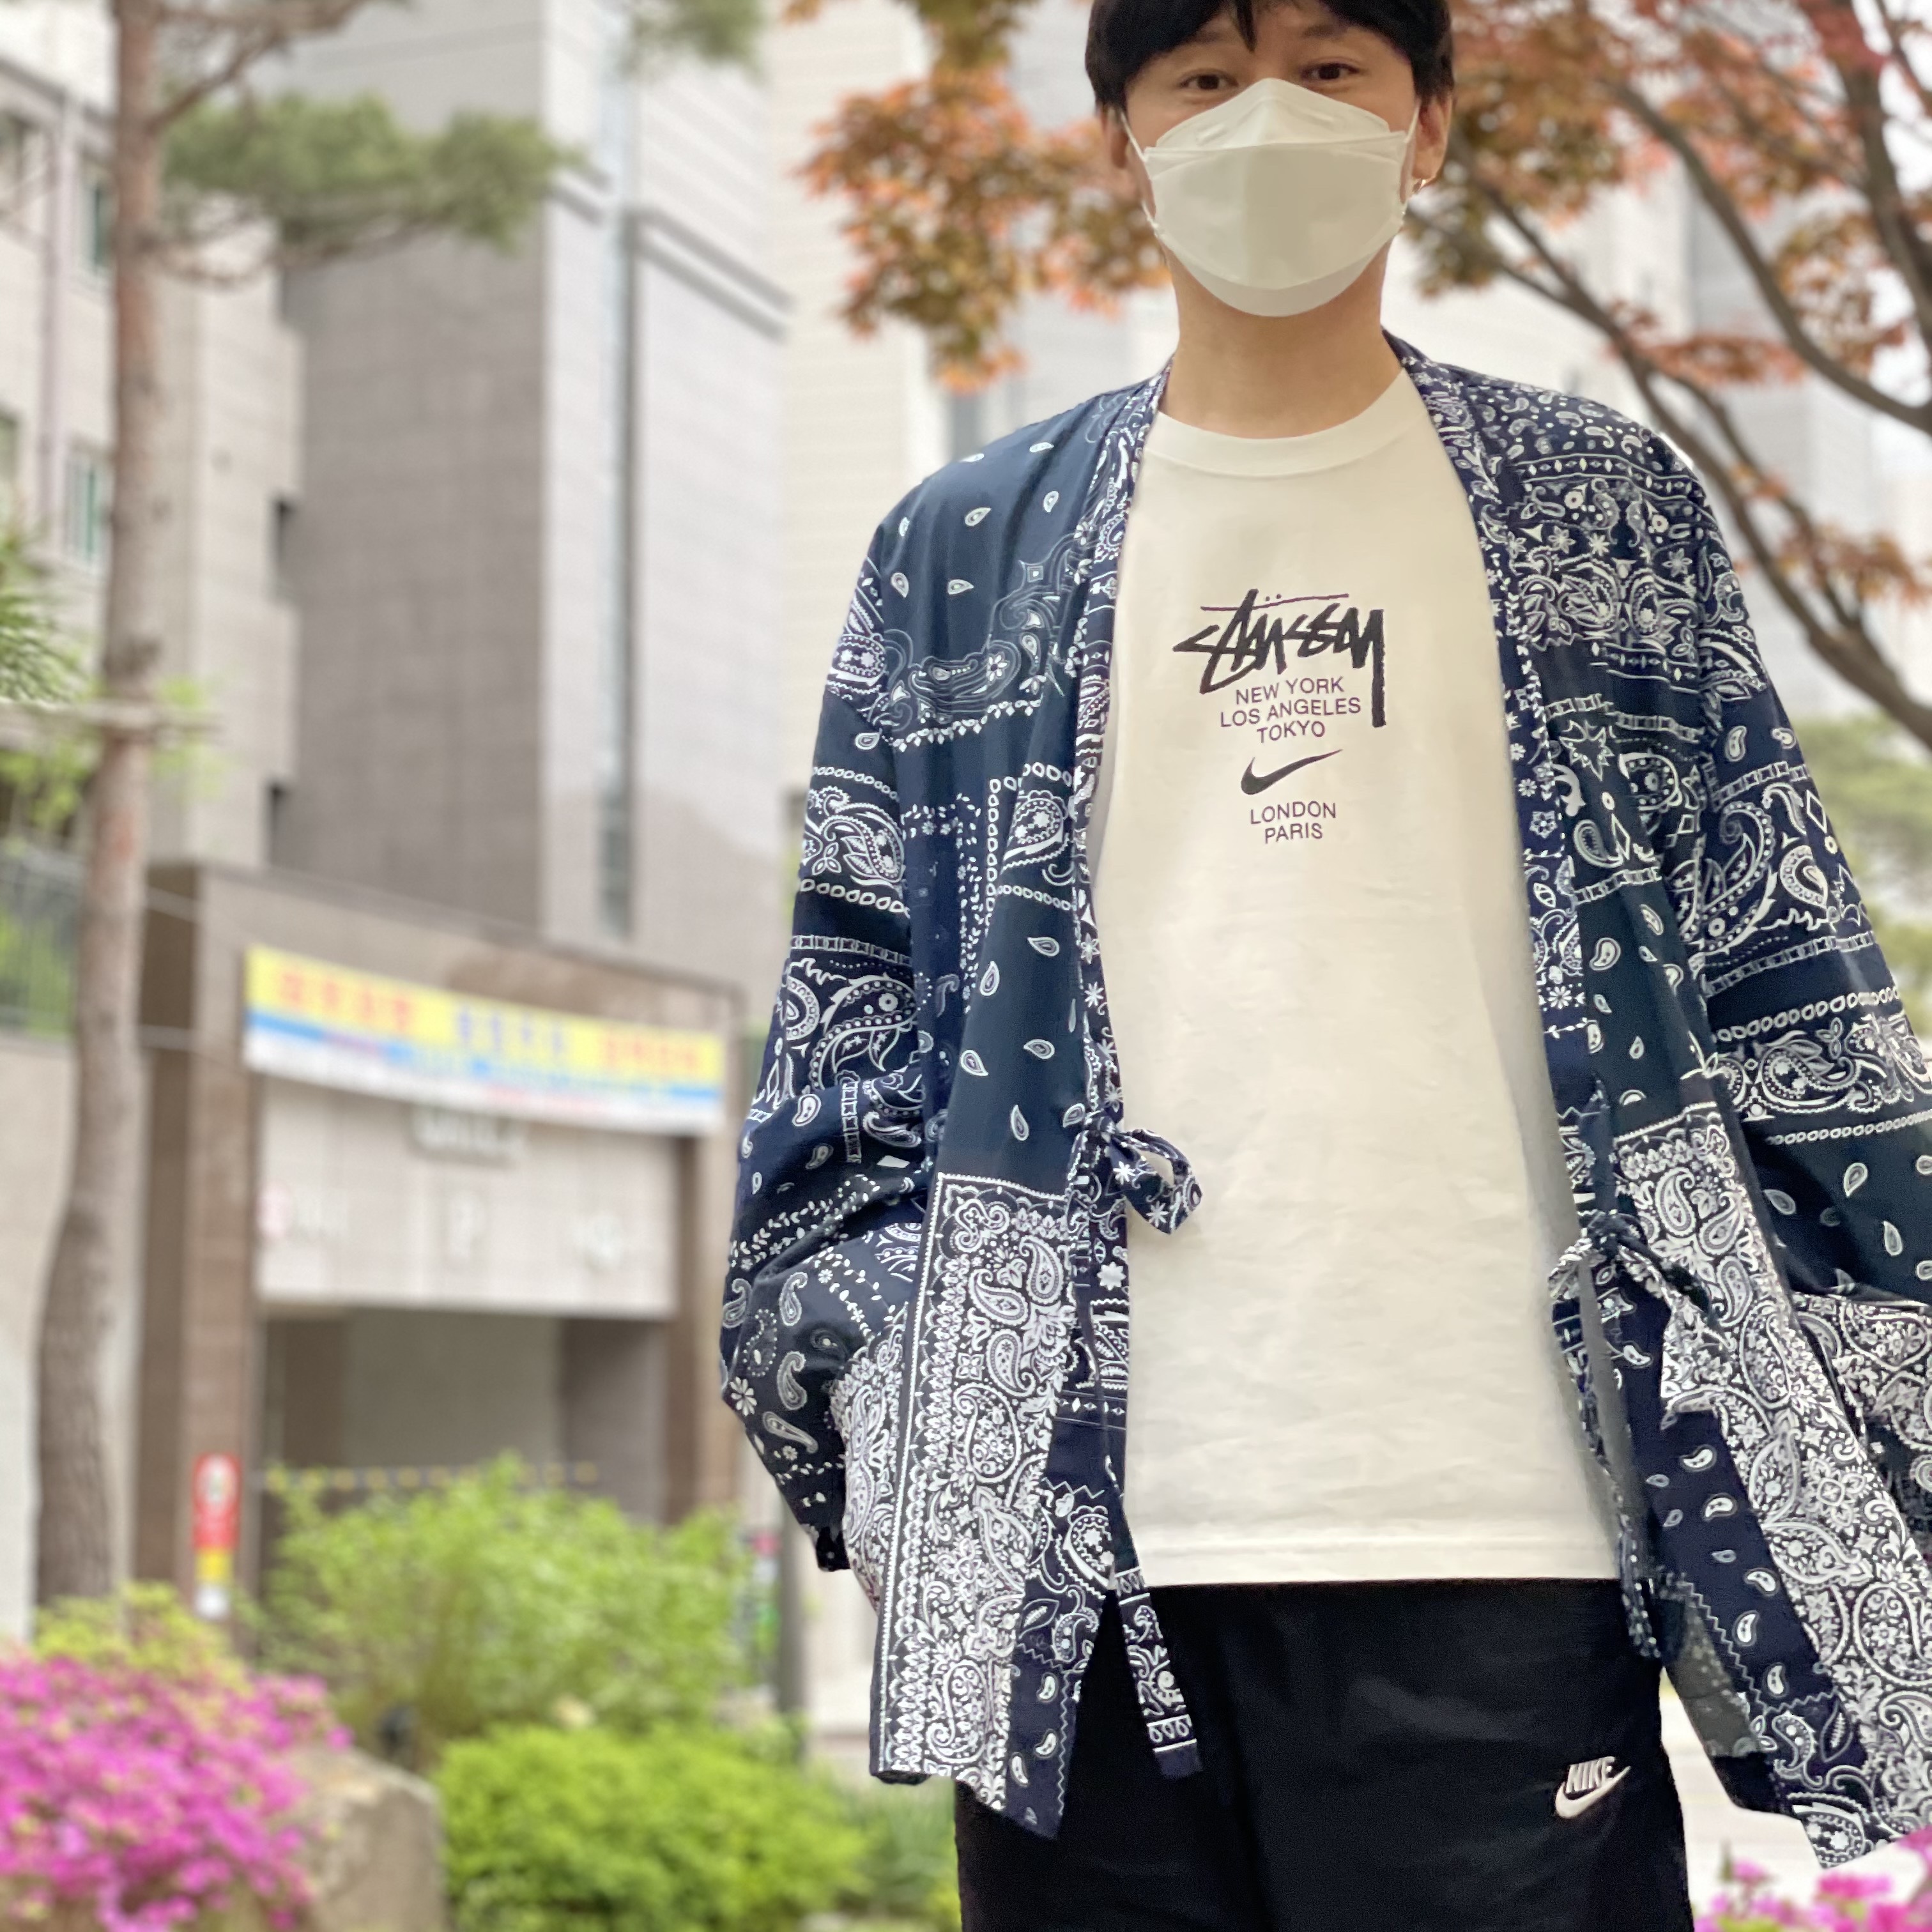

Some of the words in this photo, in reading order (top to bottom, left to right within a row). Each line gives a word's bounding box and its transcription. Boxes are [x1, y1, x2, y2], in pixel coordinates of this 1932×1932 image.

[1236, 682, 1280, 705] NEW
[1286, 676, 1344, 694] YORK
[1220, 709, 1261, 728] LOS
[1267, 697, 1361, 722] ANGELES
[1256, 720, 1326, 743] TOKYO
[1250, 801, 1337, 825] LONDON
[1264, 822, 1323, 844] PARIS
[1565, 1756, 1616, 1793] NIKE
